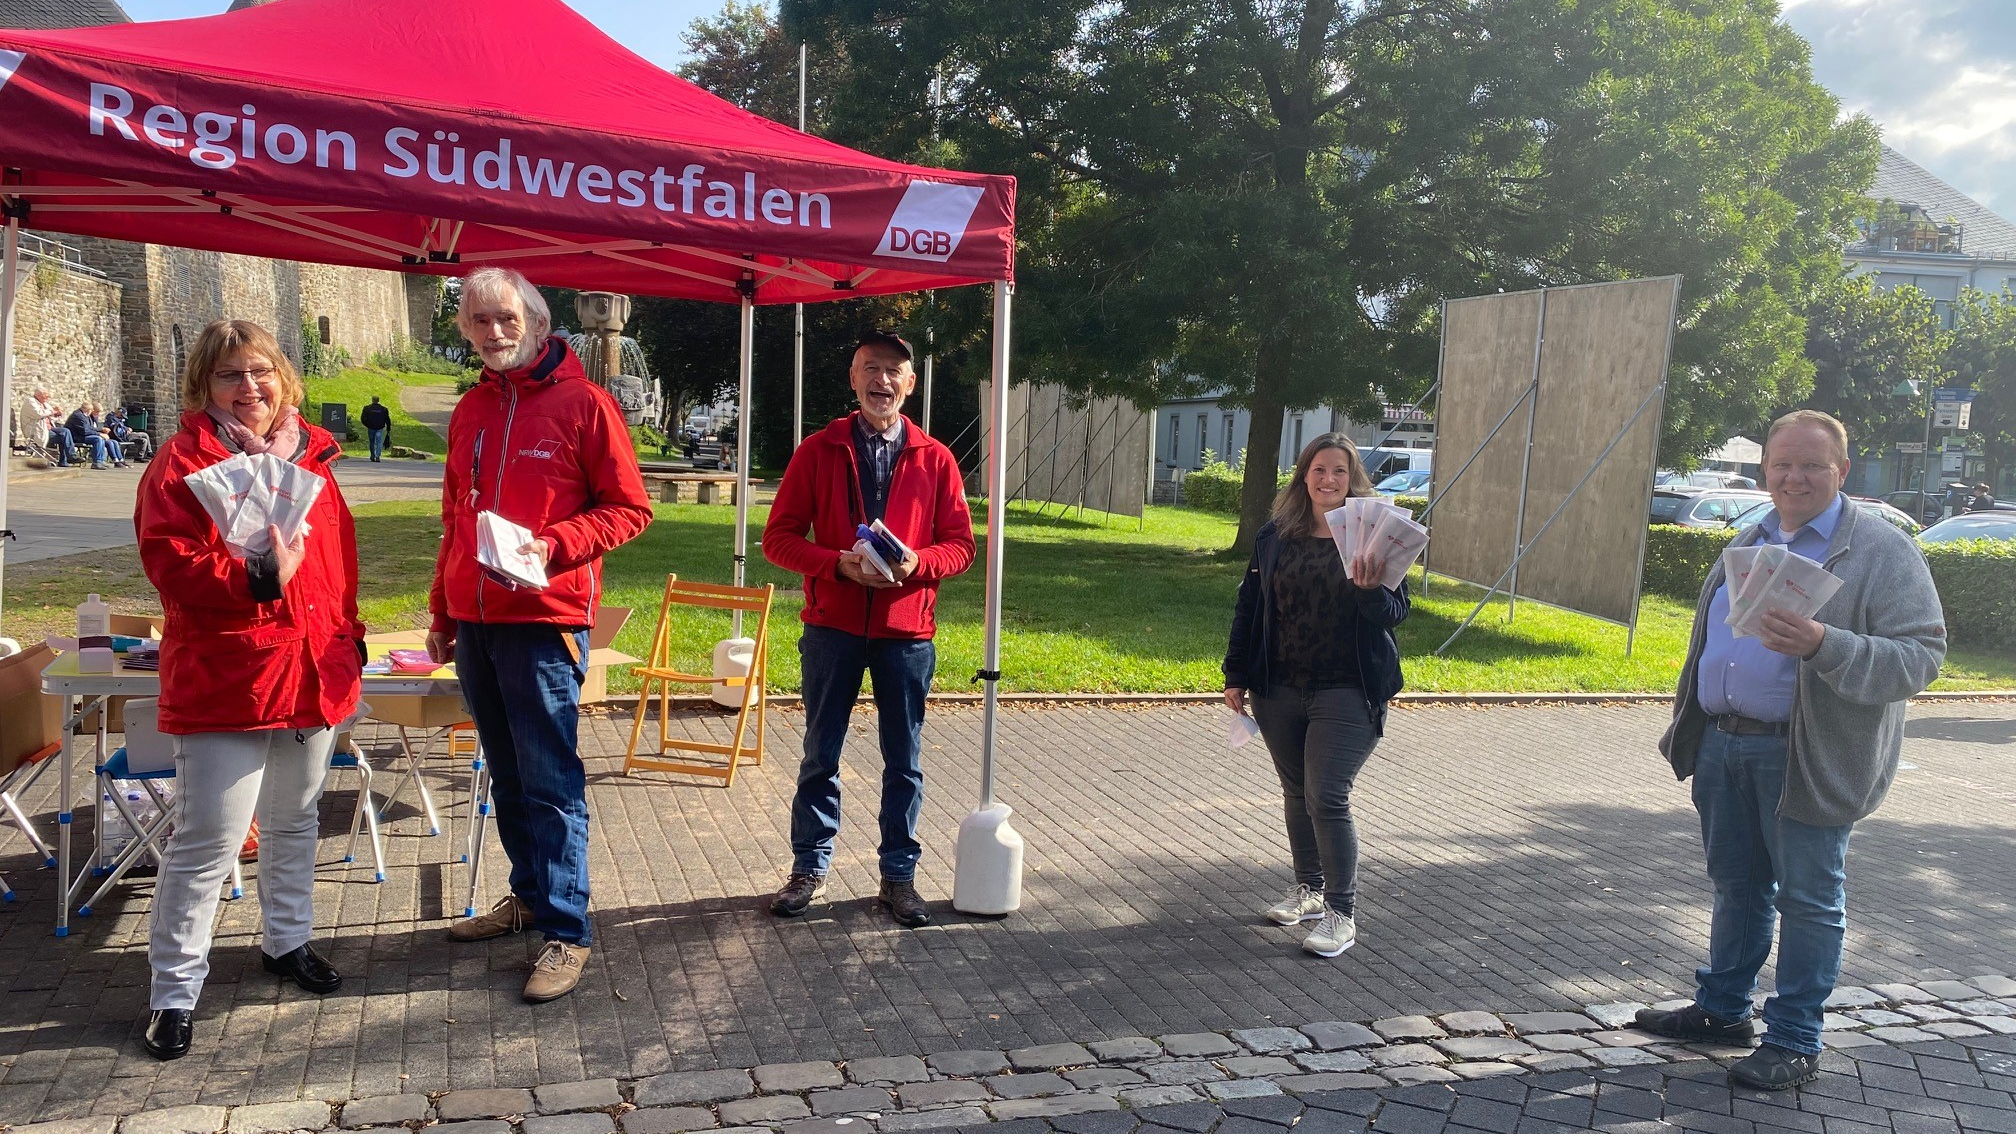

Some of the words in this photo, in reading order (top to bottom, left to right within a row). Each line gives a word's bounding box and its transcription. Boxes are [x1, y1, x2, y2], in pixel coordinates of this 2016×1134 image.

[89, 82, 357, 169] Region
[383, 126, 832, 229] Südwestfalen
[890, 226, 951, 256] DGB
[1946, 490, 1952, 499] P
